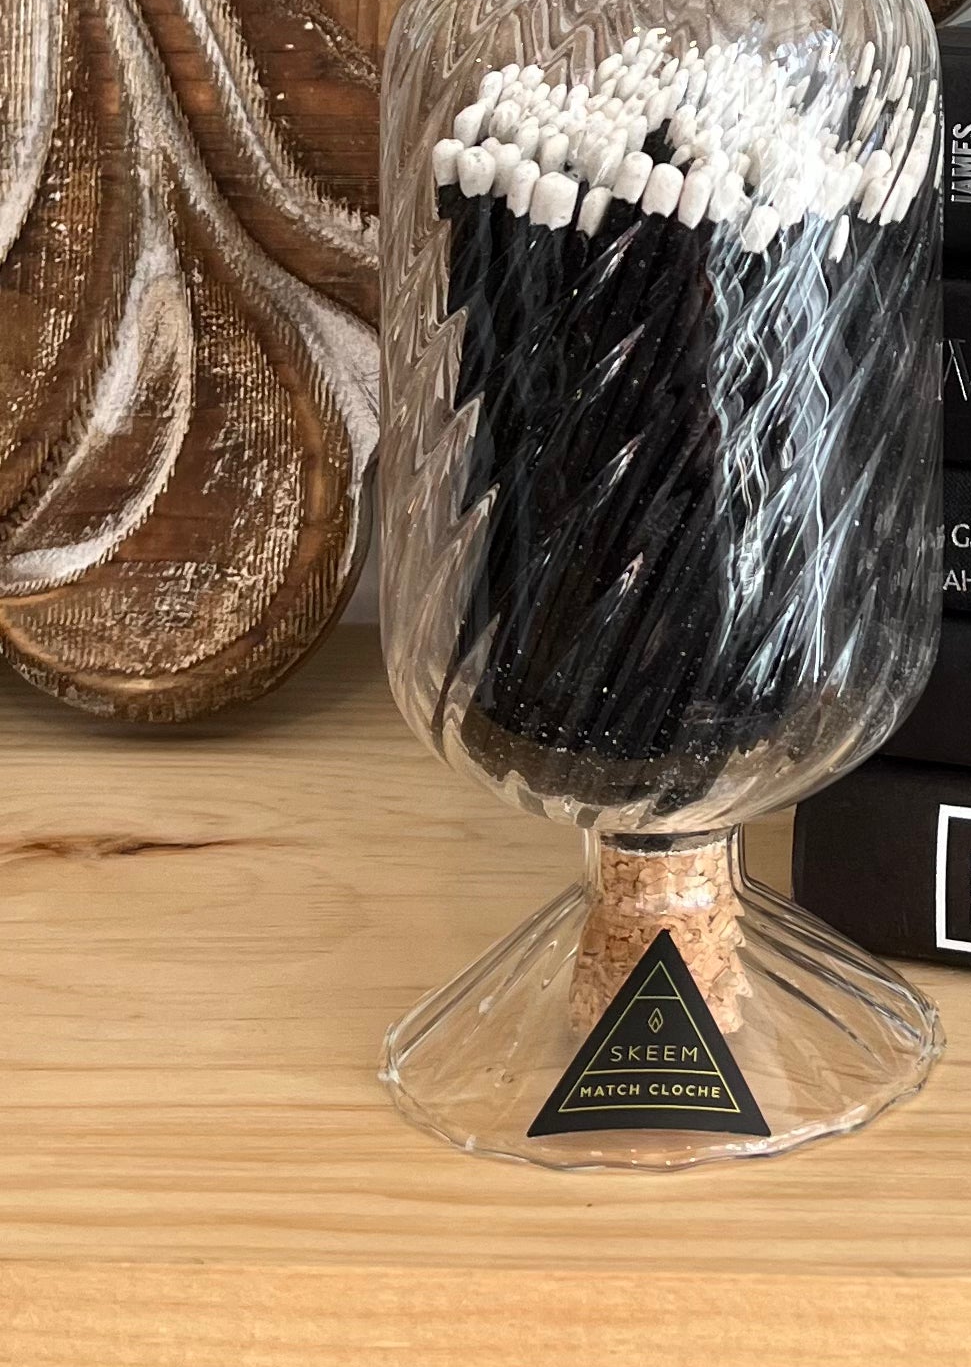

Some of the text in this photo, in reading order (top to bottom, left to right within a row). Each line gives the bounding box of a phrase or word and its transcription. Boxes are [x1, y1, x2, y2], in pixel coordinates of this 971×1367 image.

[610, 1045, 698, 1062] SKEEM
[580, 1084, 721, 1098] MATCH CLOCHE
